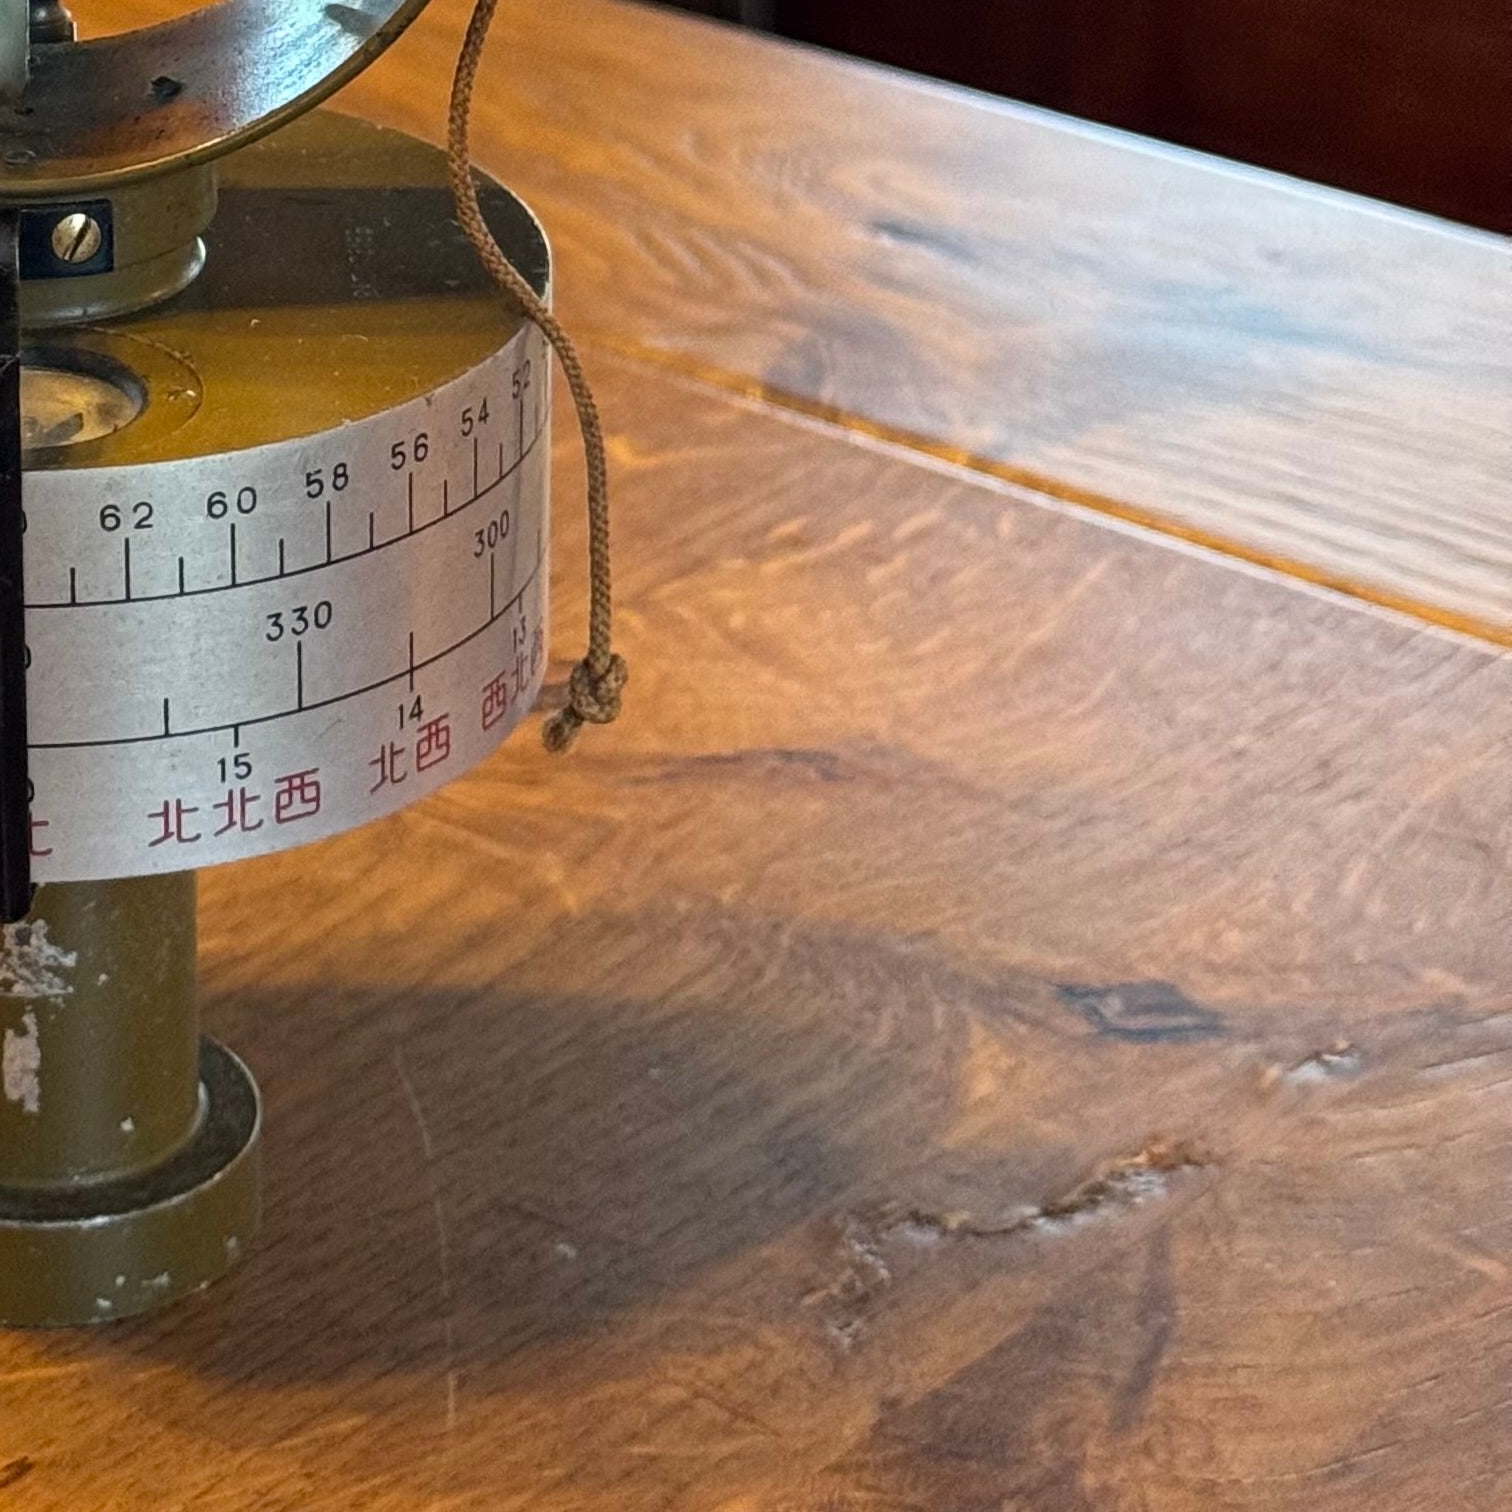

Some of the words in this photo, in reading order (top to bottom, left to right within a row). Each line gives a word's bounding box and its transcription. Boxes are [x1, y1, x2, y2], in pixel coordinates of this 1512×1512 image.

[99, 501, 154, 531] 62
[206, 486, 257, 516] 60
[305, 462, 350, 499] 58
[390, 432, 429, 471] 56
[461, 396, 489, 437] 54
[511, 359, 531, 400] 52
[265, 599, 333, 643] 330
[473, 509, 509, 558] 300
[148, 767, 321, 848] 北北西
[369, 712, 451, 794] 北西
[217, 753, 253, 783] 15
[397, 694, 424, 730] 14
